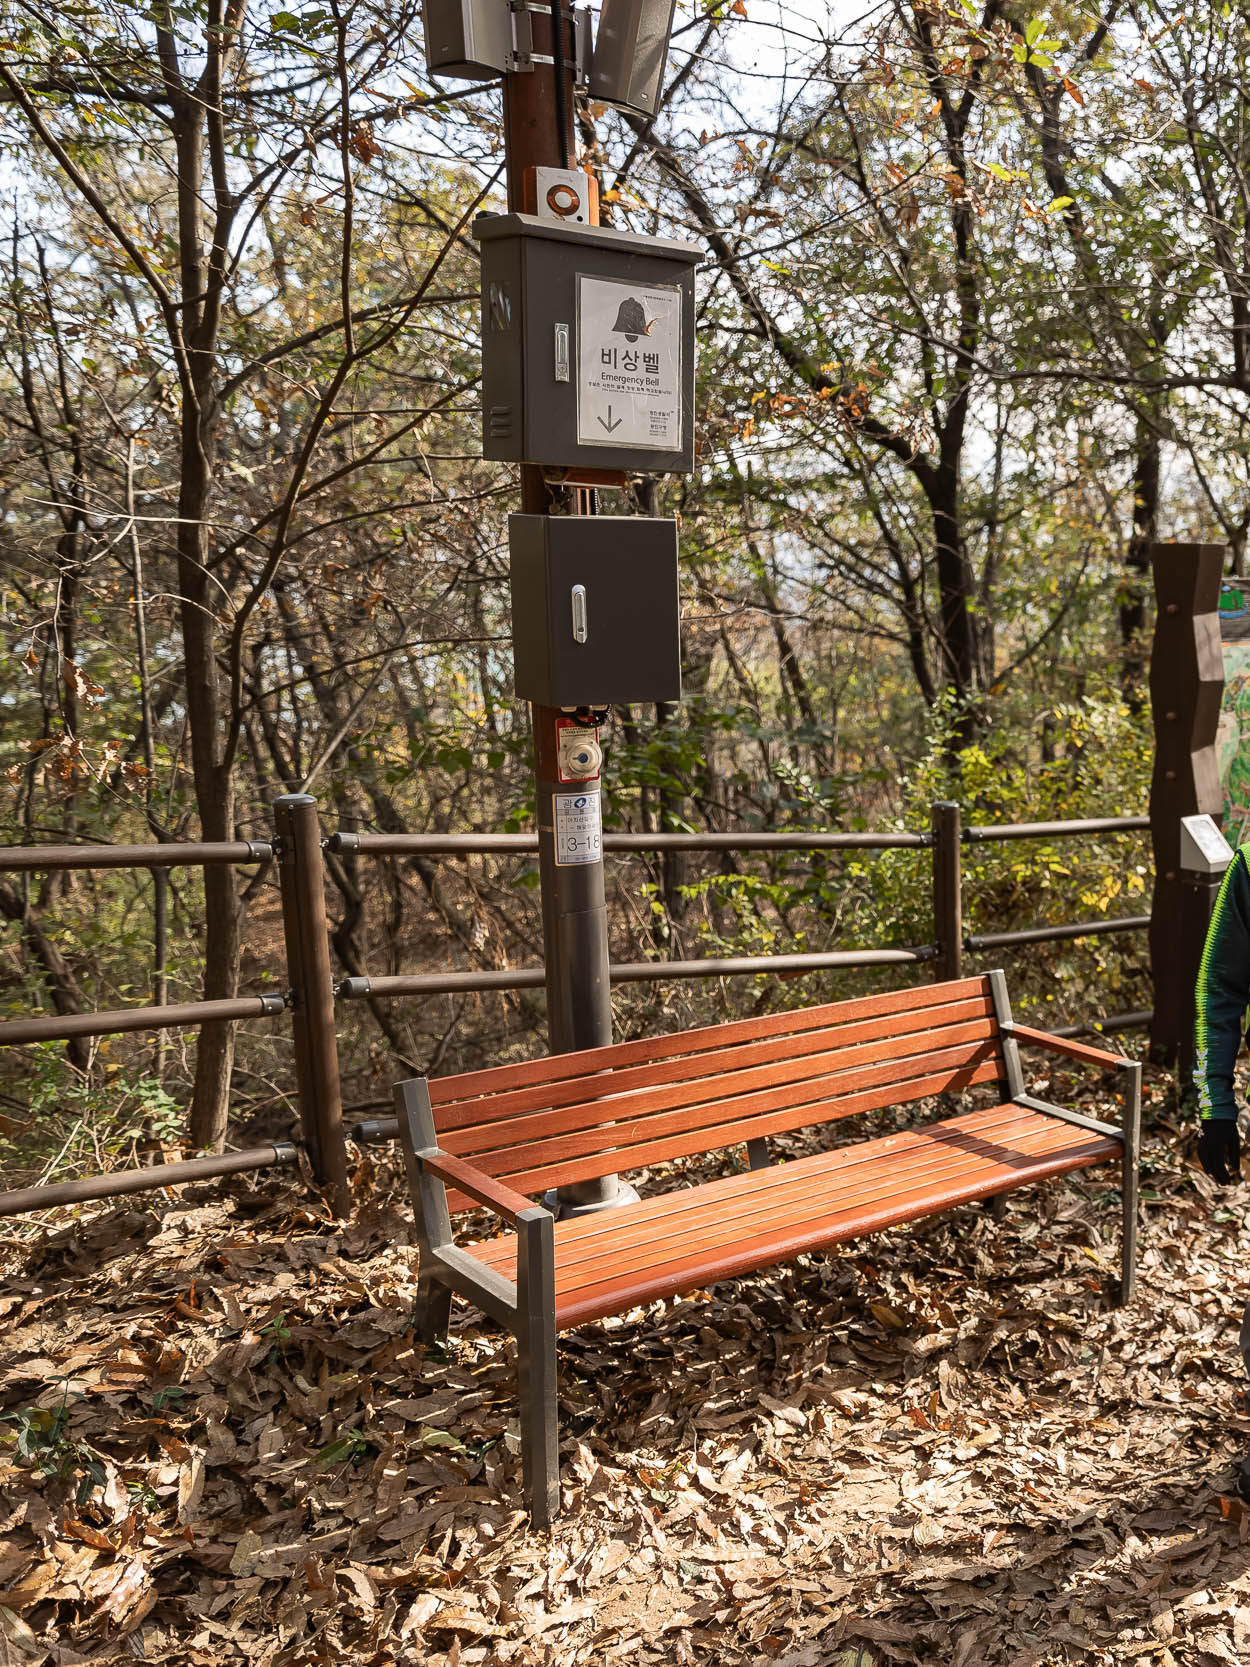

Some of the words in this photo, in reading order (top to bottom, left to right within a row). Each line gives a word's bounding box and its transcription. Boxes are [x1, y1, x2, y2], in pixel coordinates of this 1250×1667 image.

[601, 347, 659, 374] 비상벨
[601, 372, 644, 386] Emergency
[645, 377, 660, 386] Bell
[567, 834, 600, 852] 3-18
